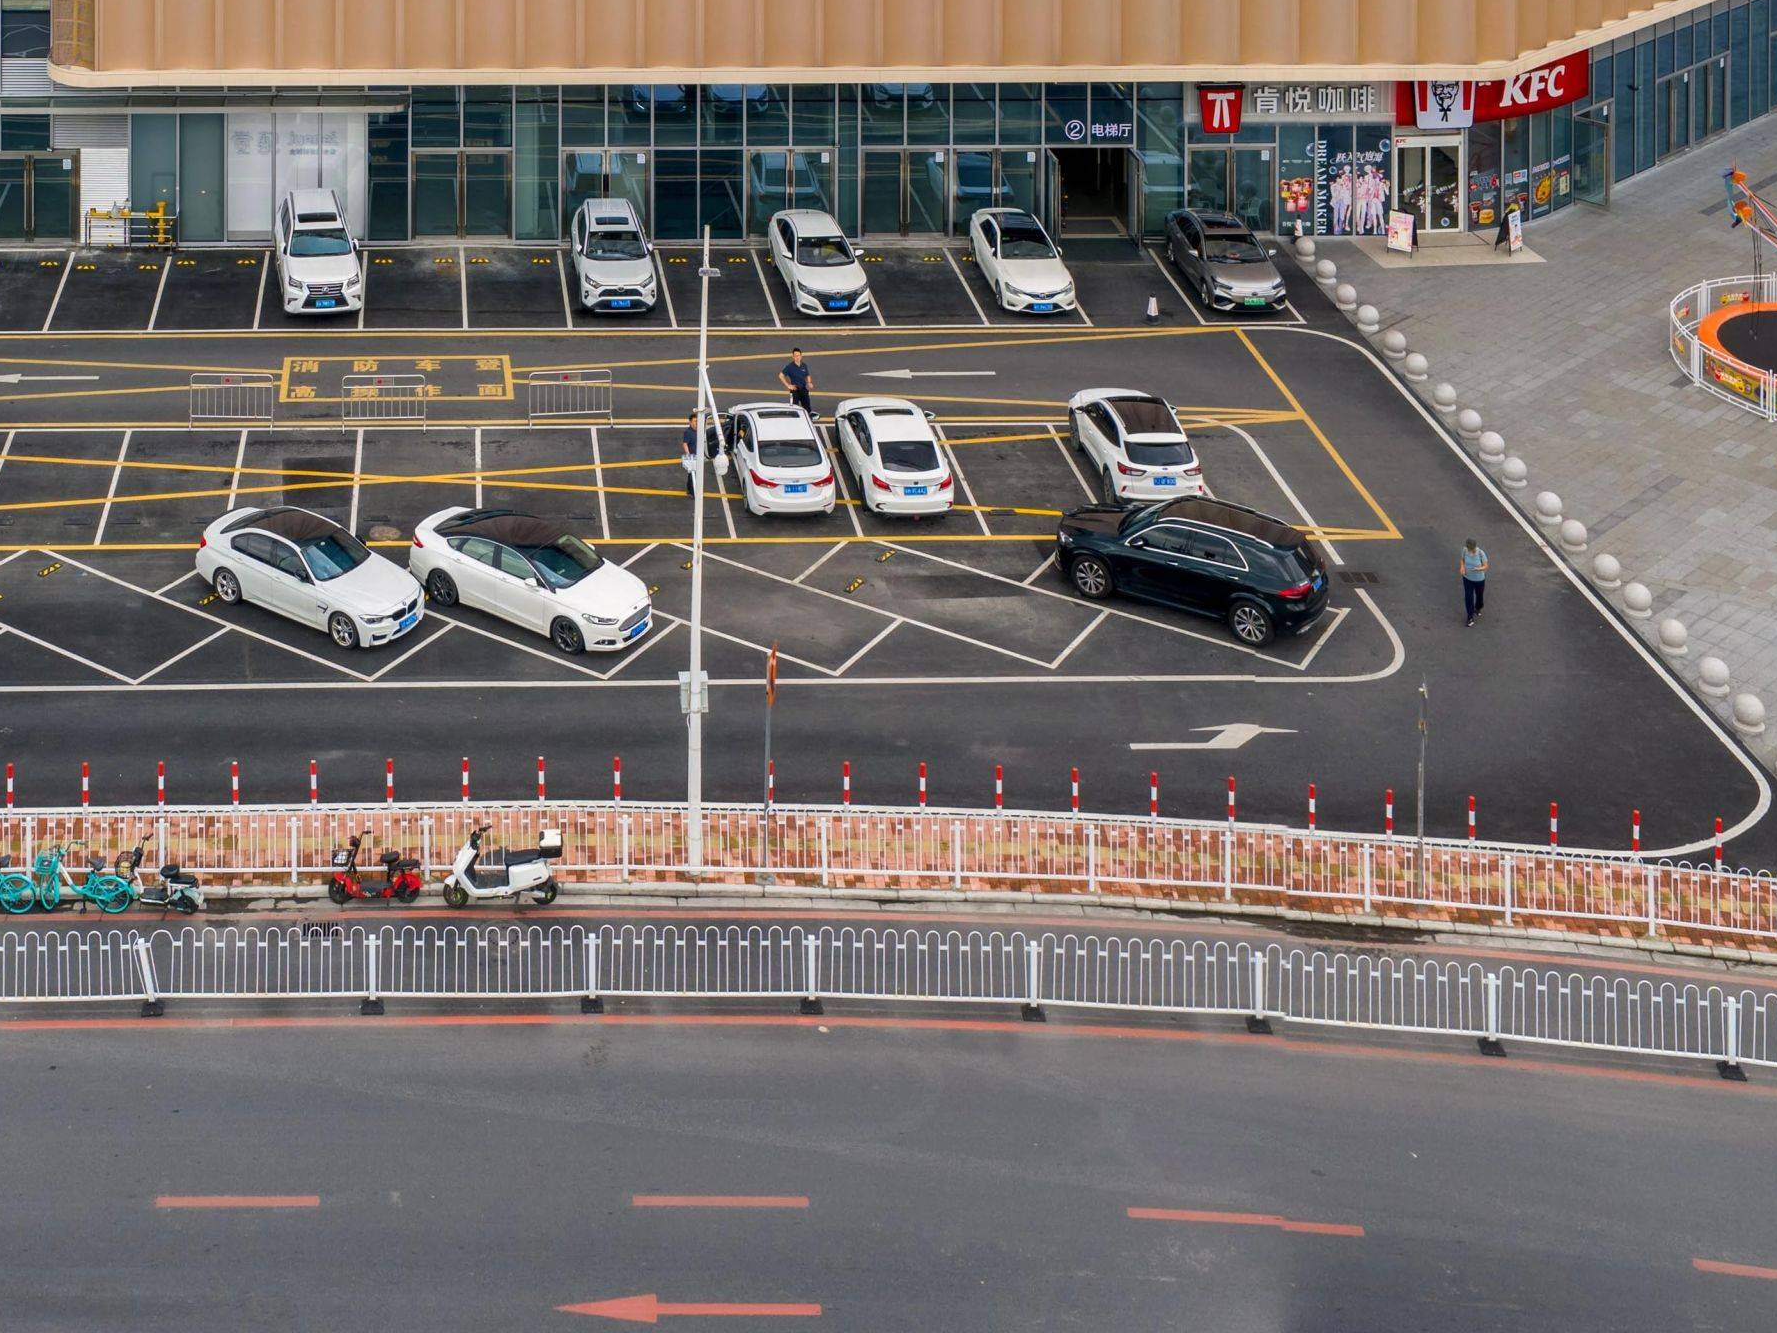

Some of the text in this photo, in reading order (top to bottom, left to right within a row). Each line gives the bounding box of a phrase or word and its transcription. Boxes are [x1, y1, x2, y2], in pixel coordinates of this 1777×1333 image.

[1253, 86, 1375, 114] 肯悦咖啡
[1499, 65, 1565, 108] KFC
[1091, 123, 1132, 137] 电梯厅
[1317, 140, 1327, 235] DREAM MAKER
